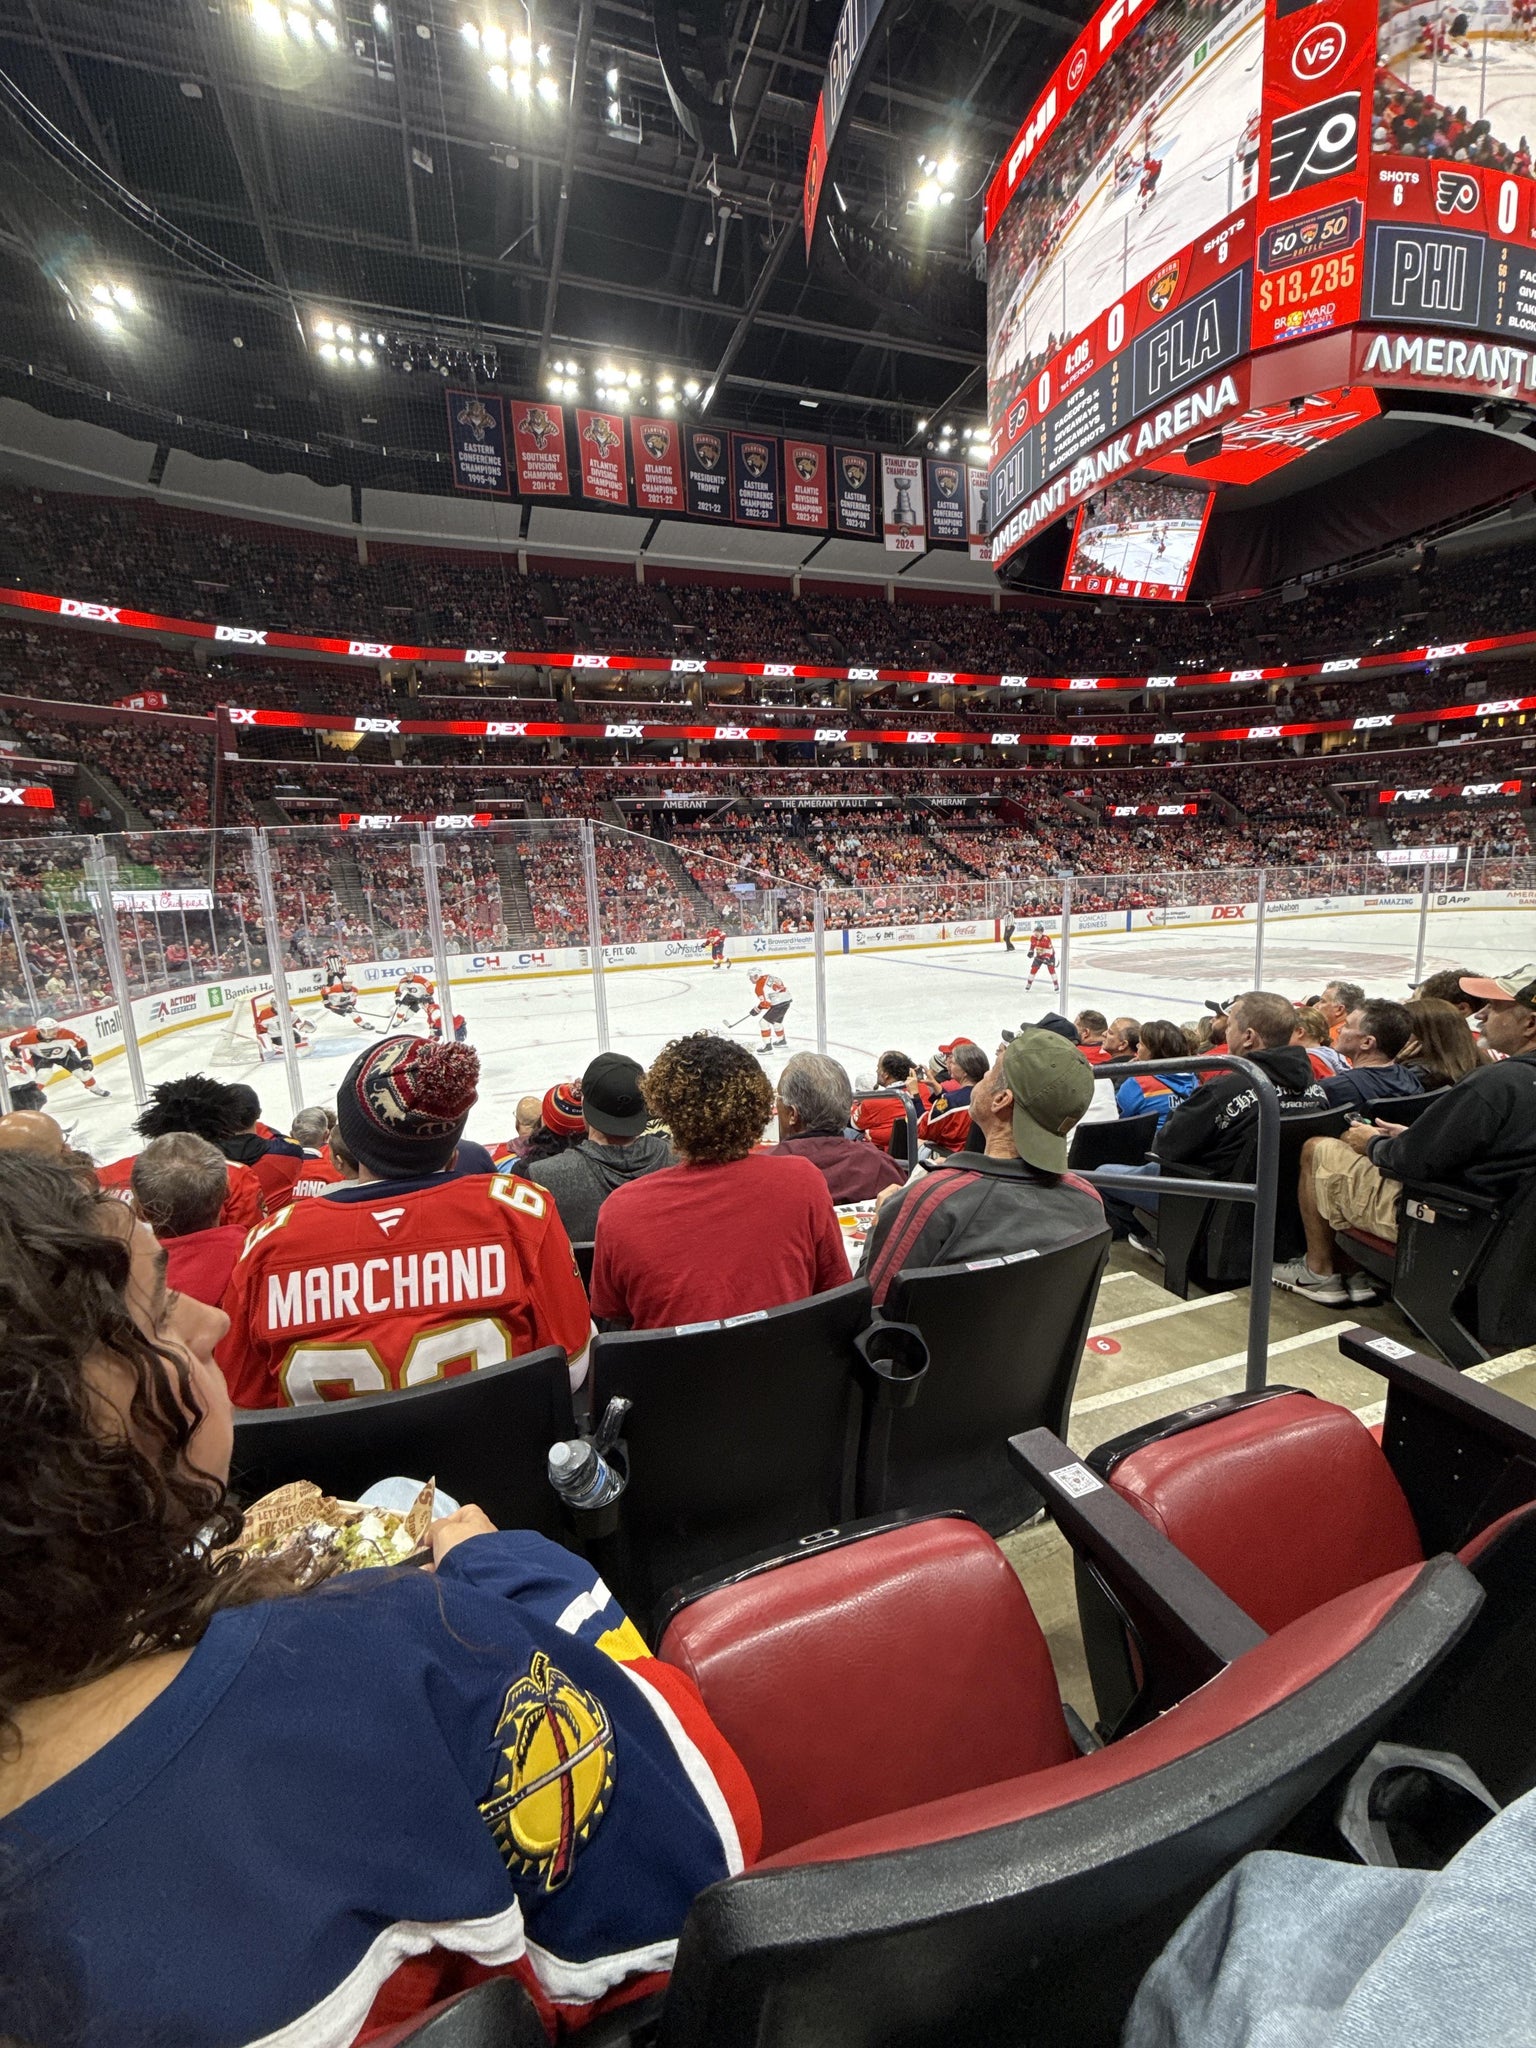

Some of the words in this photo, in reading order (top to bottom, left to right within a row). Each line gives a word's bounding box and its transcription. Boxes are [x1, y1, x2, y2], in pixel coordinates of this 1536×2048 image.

[1303, 37, 1335, 66] VS
[1008, 87, 1057, 189] PHI
[1379, 170, 1420, 184] SHOTS
[1393, 184, 1403, 207] 6
[1498, 180, 1519, 234] 0
[1203, 218, 1246, 254] SHOTS
[1271, 232, 1297, 256] 50
[1321, 215, 1348, 240] 50
[1217, 241, 1228, 264] 9
[1392, 240, 1467, 311] PHI
[1259, 254, 1356, 312] $13,235
[1303, 314, 1333, 327] COUNTY
[1496, 313, 1502, 326] 2
[1107, 304, 1124, 352] 0
[1148, 298, 1221, 395] FLA
[1064, 339, 1089, 375] 4:06
[1362, 334, 1528, 385] AMERANT
[1069, 359, 1094, 388] PERIOD
[1038, 371, 1050, 413] 0
[1067, 387, 1085, 408] HITS
[1054, 395, 1091, 431] FACEOFFS
[1054, 402, 1099, 443] GIVEAWAYS
[1053, 414, 1101, 455] TAKEAWAYS
[464, 442, 495, 455] EASTERN
[1049, 443, 1079, 472] BLOCKED
[1080, 424, 1106, 450] SHOTS
[458, 451, 502, 467] CONFERENCE
[522, 452, 560, 463] SOUTHEAST
[885, 457, 907, 468] STANLEY
[908, 460, 919, 468] CUP
[460, 462, 502, 476] CHAMPIONS
[527, 462, 557, 471] DIVISION
[589, 458, 618, 473] ATLANTIC
[644, 464, 673, 475] ATLANTIC
[991, 480, 1067, 562] AMERANT
[1069, 432, 1133, 498] BANK
[1134, 375, 1240, 457] ARENA
[522, 470, 563, 481] CHAMPIONS
[591, 467, 618, 481] DIVISION
[886, 468, 918, 477] CHAMPIONS
[587, 475, 623, 491] CHAMPIONS
[645, 473, 673, 485] DIVISION
[996, 448, 1025, 517] PHI
[532, 481, 556, 491] 2011-12
[641, 483, 678, 495] CHAMPIONS
[697, 482, 720, 494] TROPHY
[743, 480, 769, 491] EASTERN
[794, 485, 819, 496] ATLANTIC
[648, 494, 673, 505] 2021-22
[739, 489, 774, 501] CONFERENCE
[795, 494, 819, 505] DIVISION
[844, 492, 867, 502] EASTERN
[697, 501, 721, 513] 2021-22
[740, 498, 774, 510] CHAMPIONS
[791, 502, 823, 514] CHAMPIONS
[840, 500, 871, 512] CONFERENCE
[937, 500, 959, 511] EASTERN
[745, 508, 769, 519] 2022-23
[796, 512, 819, 523] 2023-24
[841, 509, 870, 521] CHAMPIONS
[932, 508, 964, 519] CONFERENCE
[933, 518, 963, 527] CHAMPIONS
[895, 538, 915, 550] 2024
[979, 549, 992, 560] 202
[60, 599, 120, 623] DEX
[215, 626, 267, 645] DEX
[349, 642, 392, 658] DEX
[1426, 643, 1468, 659] DEX
[465, 650, 506, 664] DEX
[573, 655, 610, 668] DEX
[671, 660, 707, 672] DEX
[763, 664, 796, 676] DEX
[1321, 658, 1361, 673] DEX
[848, 669, 879, 680] DEX
[927, 672, 955, 683] DEX
[1230, 670, 1264, 682] DEX
[1000, 676, 1028, 687] DEX
[1070, 679, 1098, 689] DEX
[1147, 677, 1177, 687] DEX
[1476, 699, 1522, 715] DEX
[354, 718, 401, 737] DEX
[1353, 715, 1395, 729] DEX
[486, 722, 527, 735] DEX
[605, 721, 644, 737] DEX
[715, 727, 749, 739] DEX
[1248, 726, 1282, 738] DEX
[814, 730, 847, 741] DEX
[907, 732, 937, 743] DEX
[992, 734, 1020, 744] DEX
[1070, 736, 1097, 745] DEX
[1154, 733, 1185, 744] DEX
[1461, 783, 1503, 795] DEX
[663, 801, 707, 809] AMERANT
[781, 800, 796, 808] THE
[798, 800, 837, 808] AMERANT
[839, 799, 867, 807] VAULT
[931, 798, 966, 806] AMERANT
[1157, 805, 1184, 815] DEX
[435, 815, 475, 829] DEX
[1266, 903, 1299, 913] AutoNation
[1379, 898, 1414, 906] AMAZING
[1078, 913, 1107, 922] COMCAST
[1211, 906, 1246, 919] DEX
[953, 925, 976, 936] Coca-Cola
[1078, 920, 1107, 929] BUSINESS
[613, 947, 624, 956] FIT.
[664, 942, 703, 956] Surfside
[472, 956, 500, 968] CH
[518, 953, 545, 965] CH
[381, 965, 436, 978] HOND
[170, 993, 196, 1007] ACTION
[1415, 1203, 1424, 1218] 6
[267, 1244, 507, 1331] MARCHAND
[1096, 1339, 1110, 1352] 6
